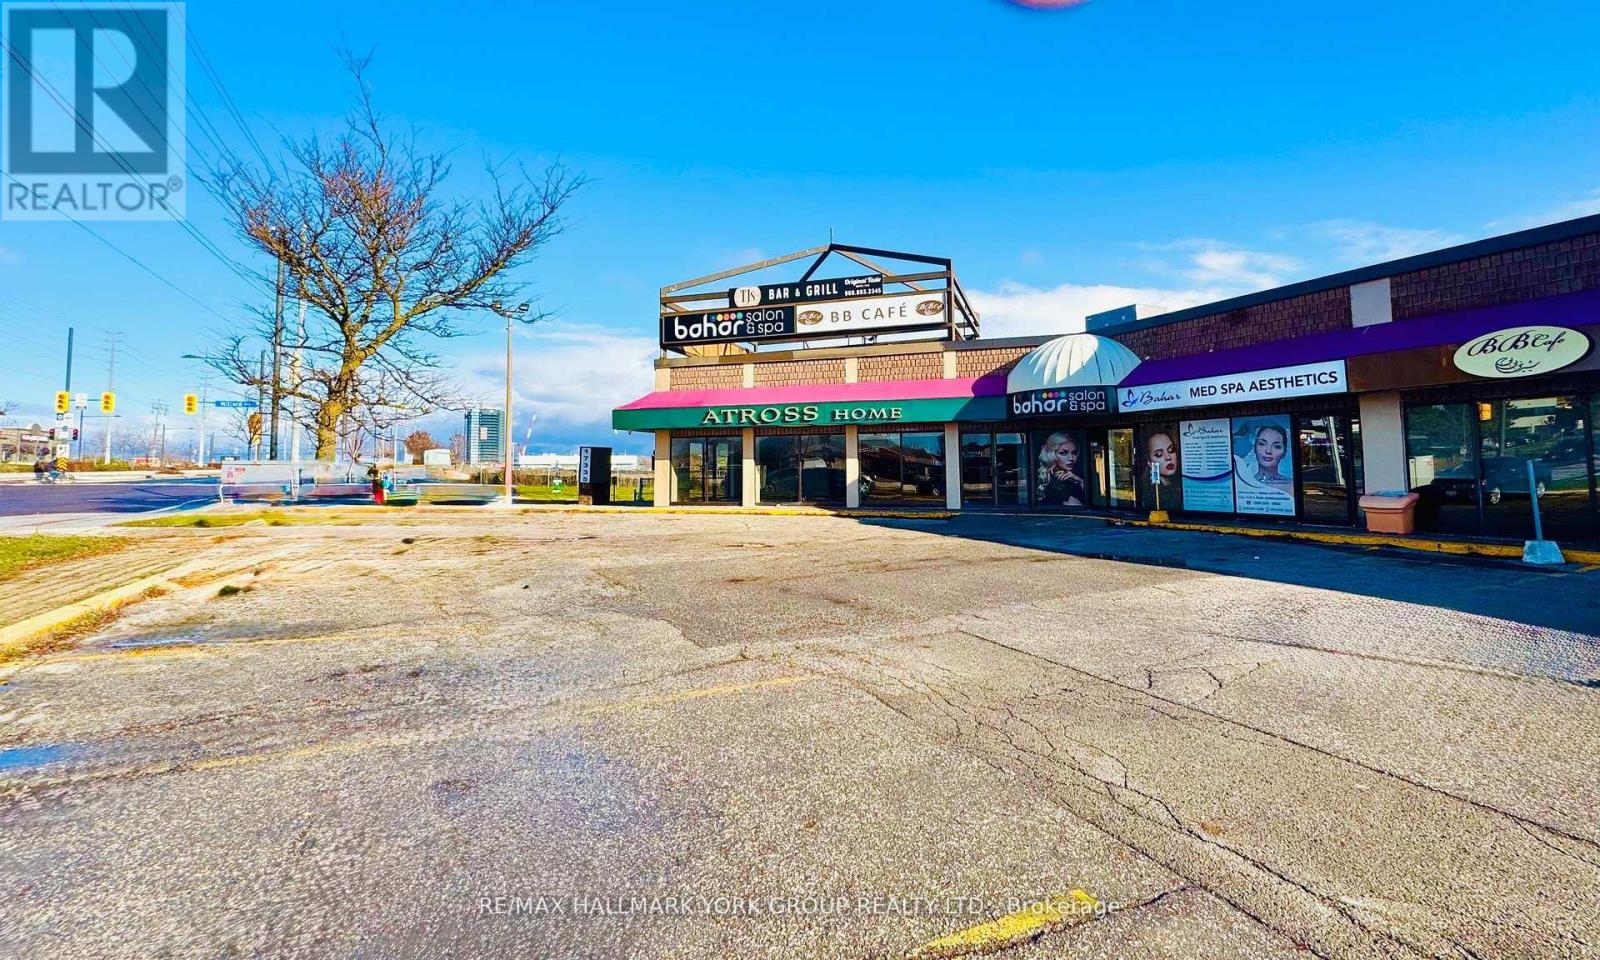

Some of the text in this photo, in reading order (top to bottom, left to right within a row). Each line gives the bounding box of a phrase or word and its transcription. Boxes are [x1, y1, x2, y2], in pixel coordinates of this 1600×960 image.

[768, 287, 790, 300] BAR
[794, 288, 801, 297] &
[806, 282, 838, 297] GRILL
[830, 310, 852, 323] BB
[861, 302, 907, 320] CAFÉ
[674, 309, 784, 339] bahar salon
[746, 321, 784, 335] & spa
[1139, 371, 1338, 404] Bahar MED SPA AESTHETICS
[1013, 390, 1105, 414] bahar salon
[1069, 401, 1105, 413] & spa
[702, 406, 902, 424] ATROSS HOME
